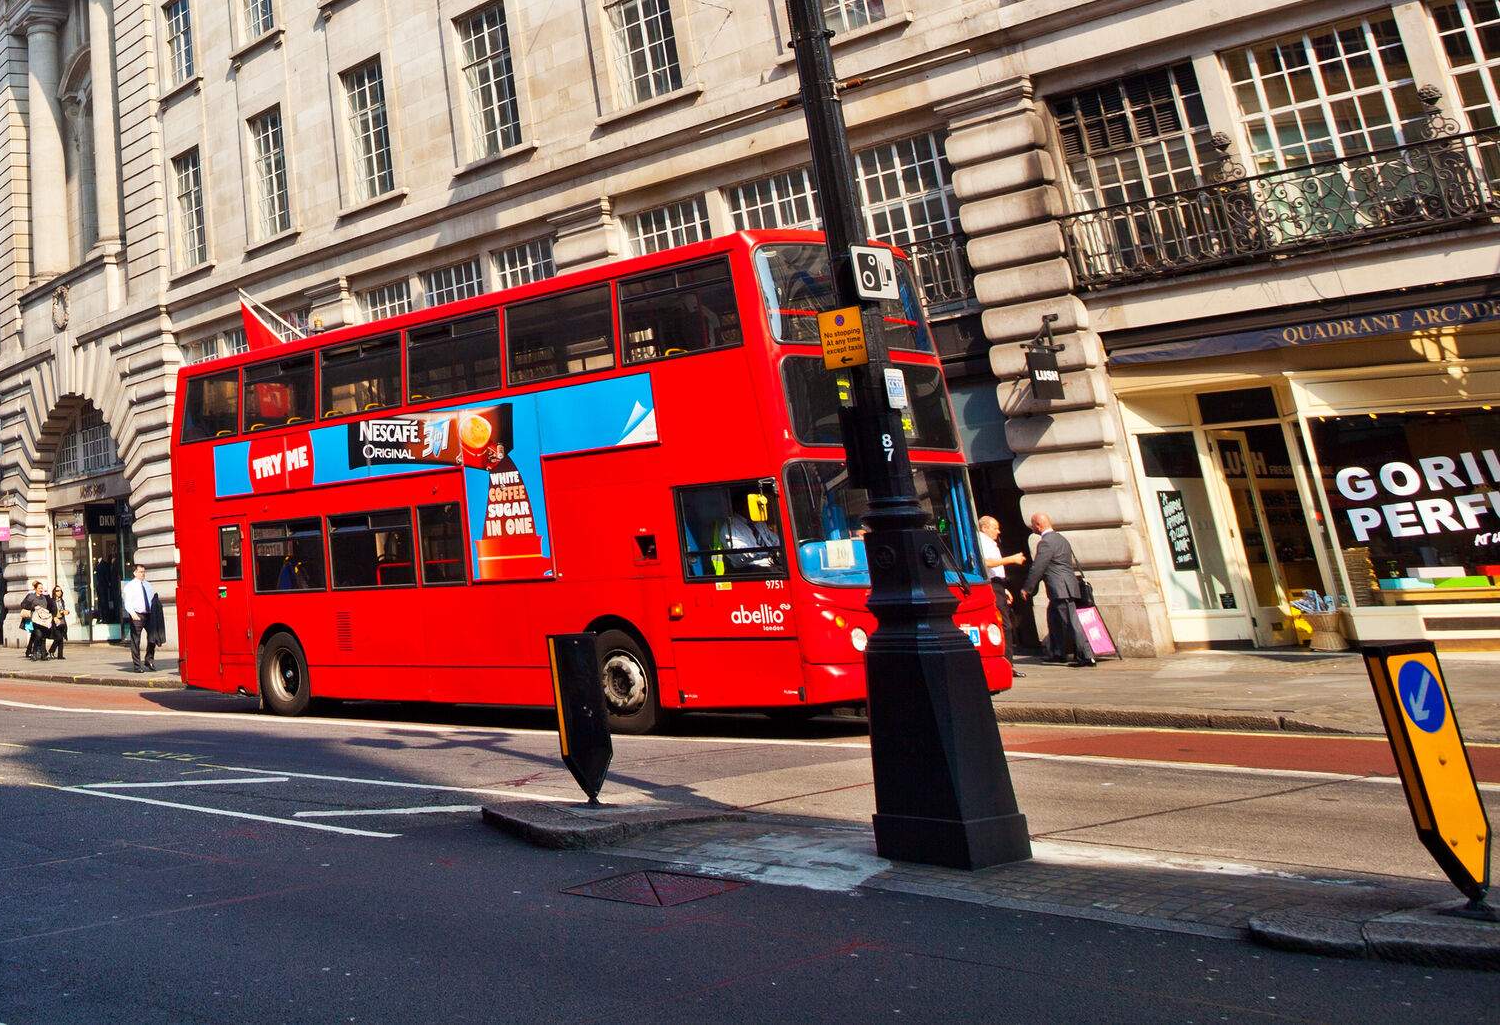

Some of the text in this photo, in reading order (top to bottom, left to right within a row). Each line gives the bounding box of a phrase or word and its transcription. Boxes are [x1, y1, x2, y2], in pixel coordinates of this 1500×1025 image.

[1282, 299, 1500, 346] QUADRANT ARCADE
[824, 327, 861, 339] No stopping
[835, 338, 846, 347] any
[847, 335, 861, 344] time
[826, 343, 863, 356] except taxis
[1034, 369, 1060, 382] LUSH
[359, 419, 420, 444] NESCAFÉ
[362, 443, 415, 460] ORIGINAL
[253, 446, 308, 479] TRY ME
[1224, 451, 1268, 475] UH
[490, 470, 520, 486] WHITE
[488, 485, 526, 502] COFFEE
[488, 501, 530, 519] SUGAR
[486, 517, 533, 537] IN ONE
[765, 580, 784, 589] 9751
[730, 604, 784, 625] abellio
